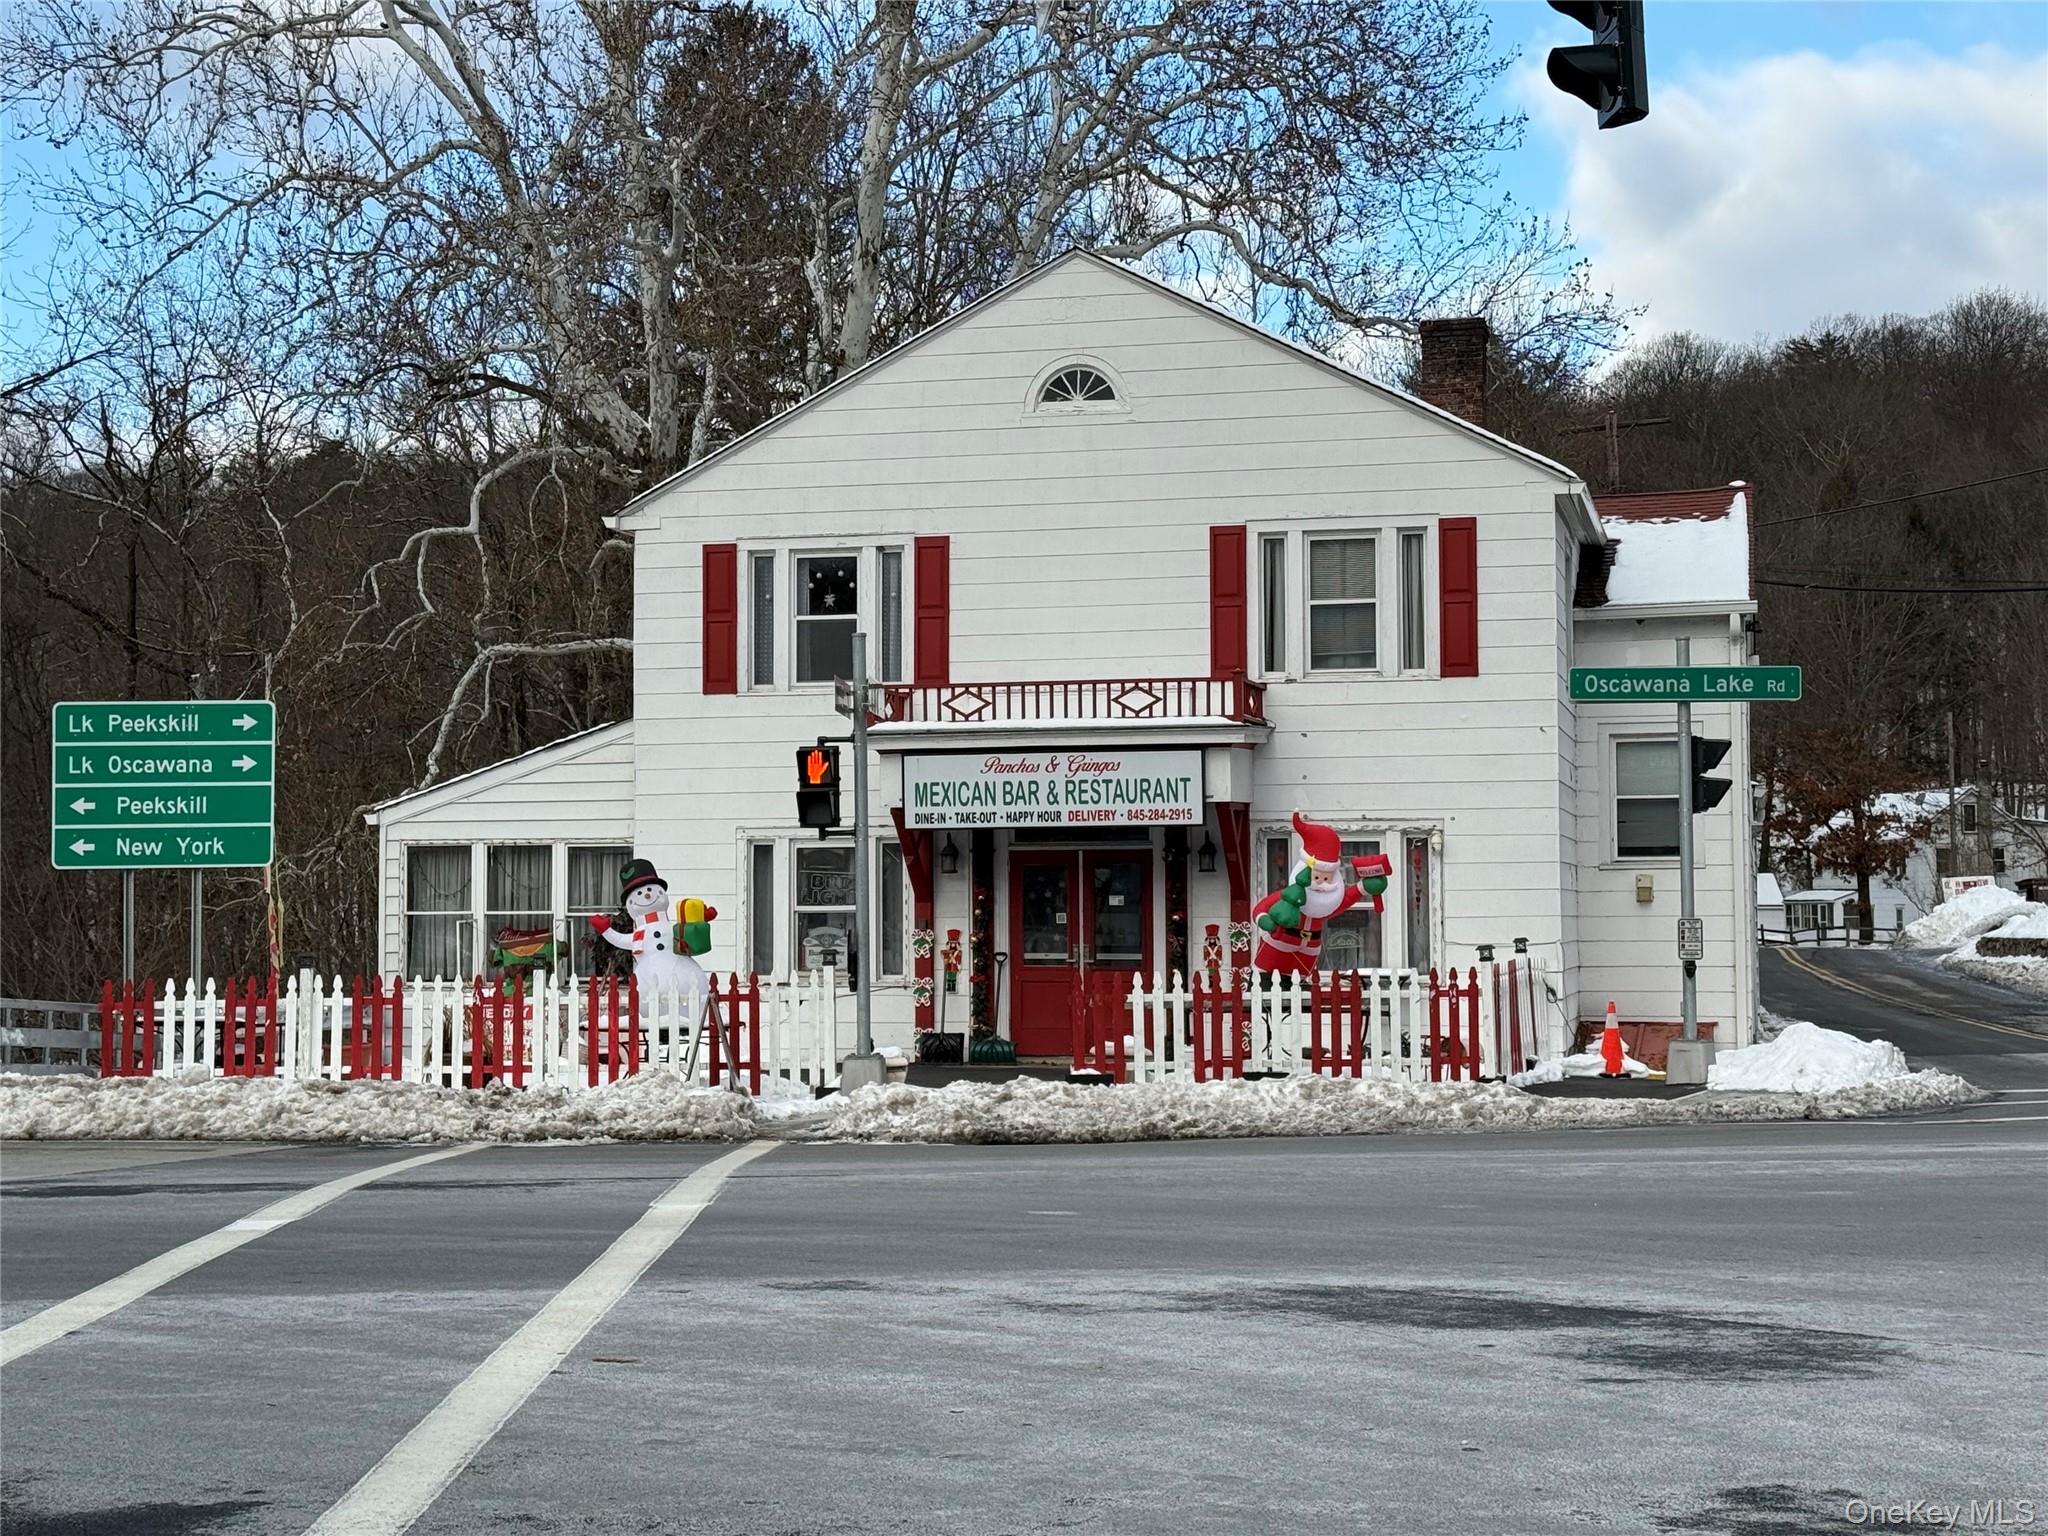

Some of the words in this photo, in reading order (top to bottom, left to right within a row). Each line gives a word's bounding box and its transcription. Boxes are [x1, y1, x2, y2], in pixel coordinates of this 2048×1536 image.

[1584, 674, 1690, 693] Oscawana
[1703, 674, 1754, 693] Lake
[1767, 679, 1786, 693] Rd
[68, 714, 95, 733] Lk
[108, 713, 200, 733] Peekskill
[68, 756, 95, 774] Lk
[108, 755, 213, 774] Oscawana
[980, 756, 1040, 774] Panchos
[1045, 755, 1061, 773] &
[1065, 754, 1121, 778] Gringos
[914, 781, 996, 808] MEXICAN
[1002, 780, 1041, 806] BAR
[1046, 779, 1060, 806] &
[1065, 776, 1192, 805] RESTAURANT
[117, 796, 207, 815] Peekskill
[914, 812, 947, 825] DINE-IN
[955, 811, 998, 824] TAKE-OUT
[1006, 810, 1035, 824] HAPPY
[1037, 810, 1062, 823] HOUR
[1068, 809, 1117, 822] DELIVERY
[1127, 807, 1193, 821] 845-284-2915
[116, 838, 163, 856] New
[176, 836, 225, 856] York
